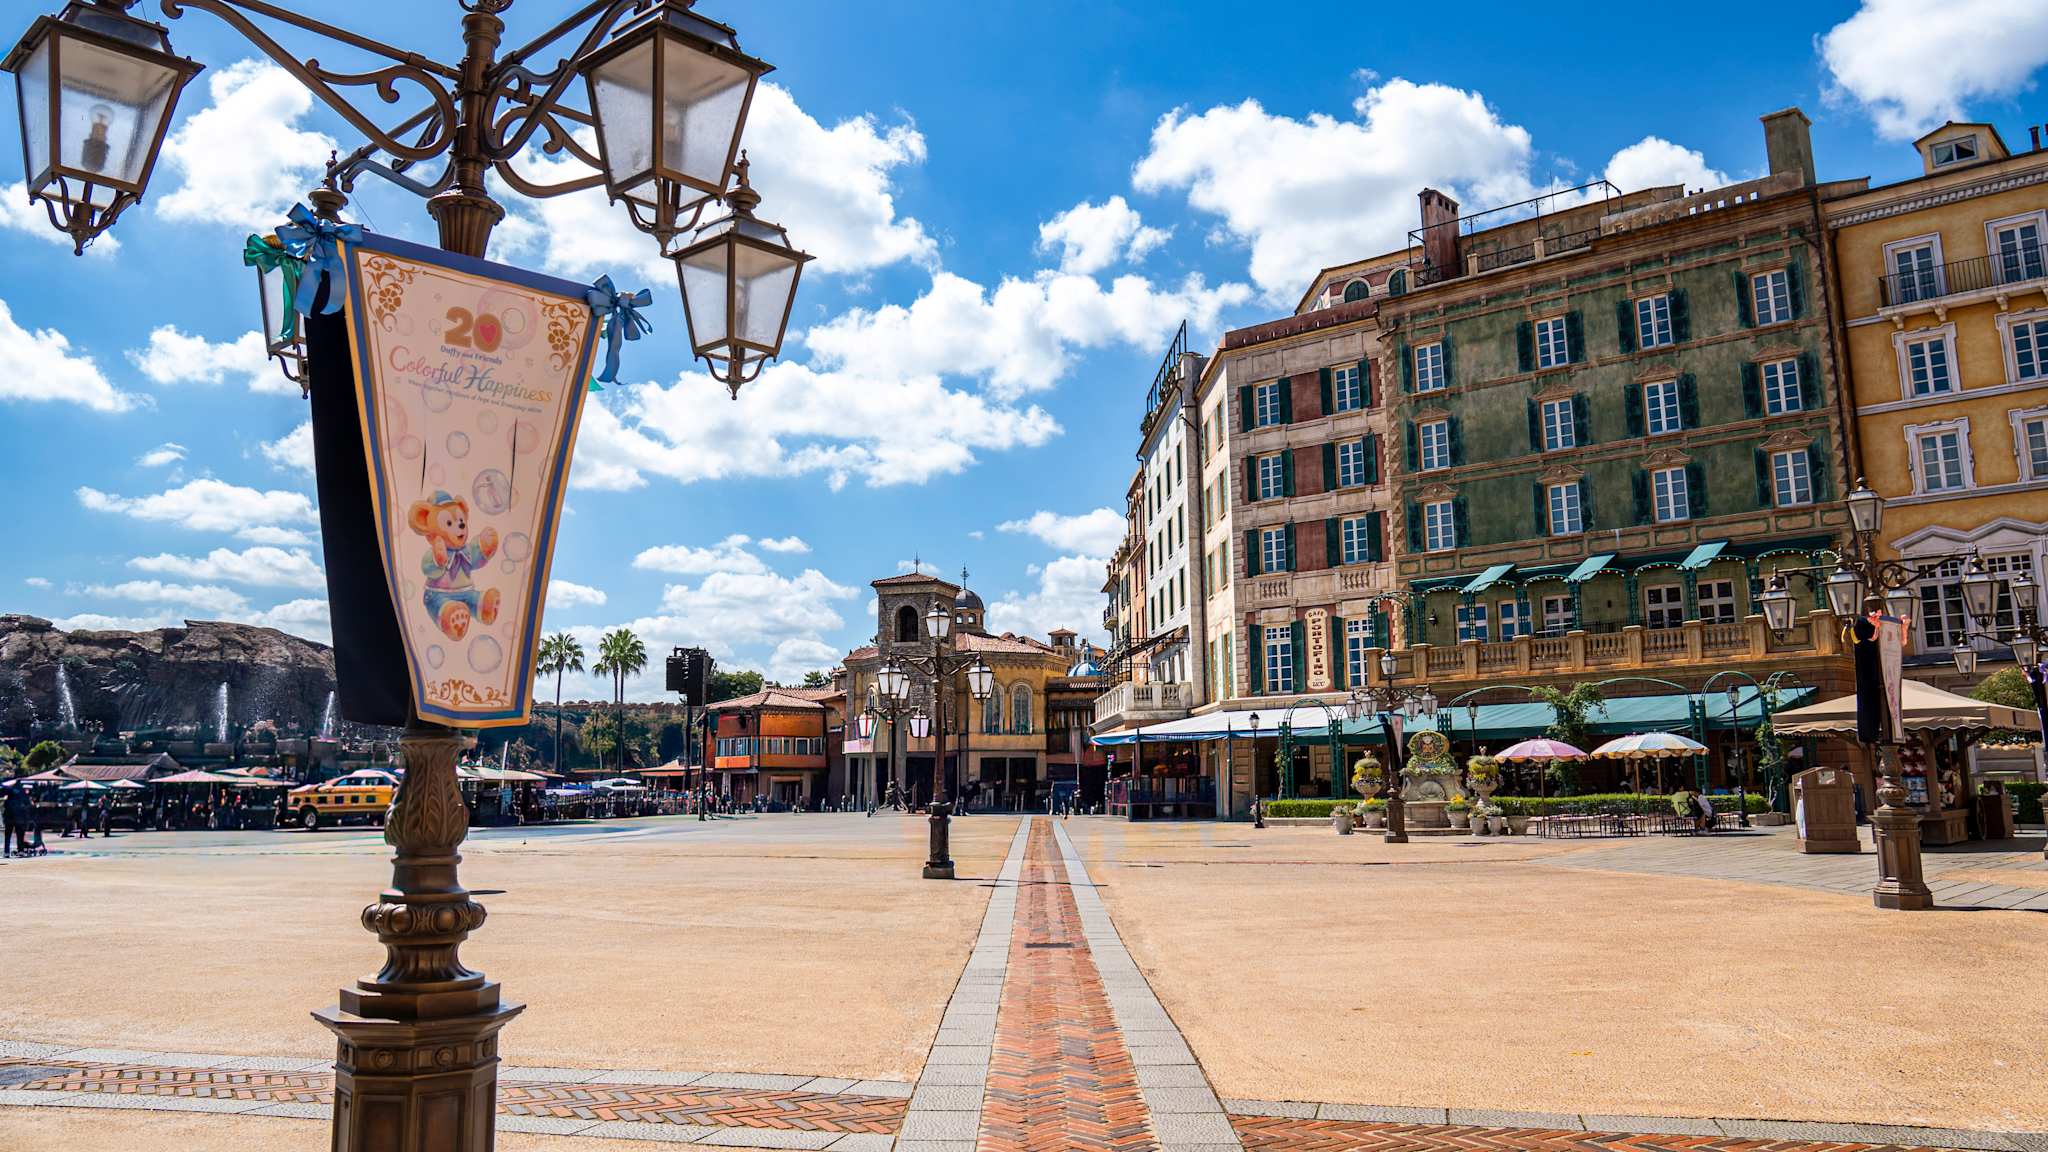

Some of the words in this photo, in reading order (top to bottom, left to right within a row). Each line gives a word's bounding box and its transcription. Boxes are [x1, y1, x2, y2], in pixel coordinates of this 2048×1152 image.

[389, 345, 465, 385] Colorful
[463, 364, 553, 402] Happiness
[440, 345, 462, 359] Duffy
[474, 353, 502, 365] Friends
[1311, 618, 1324, 676] PORTOFINO
